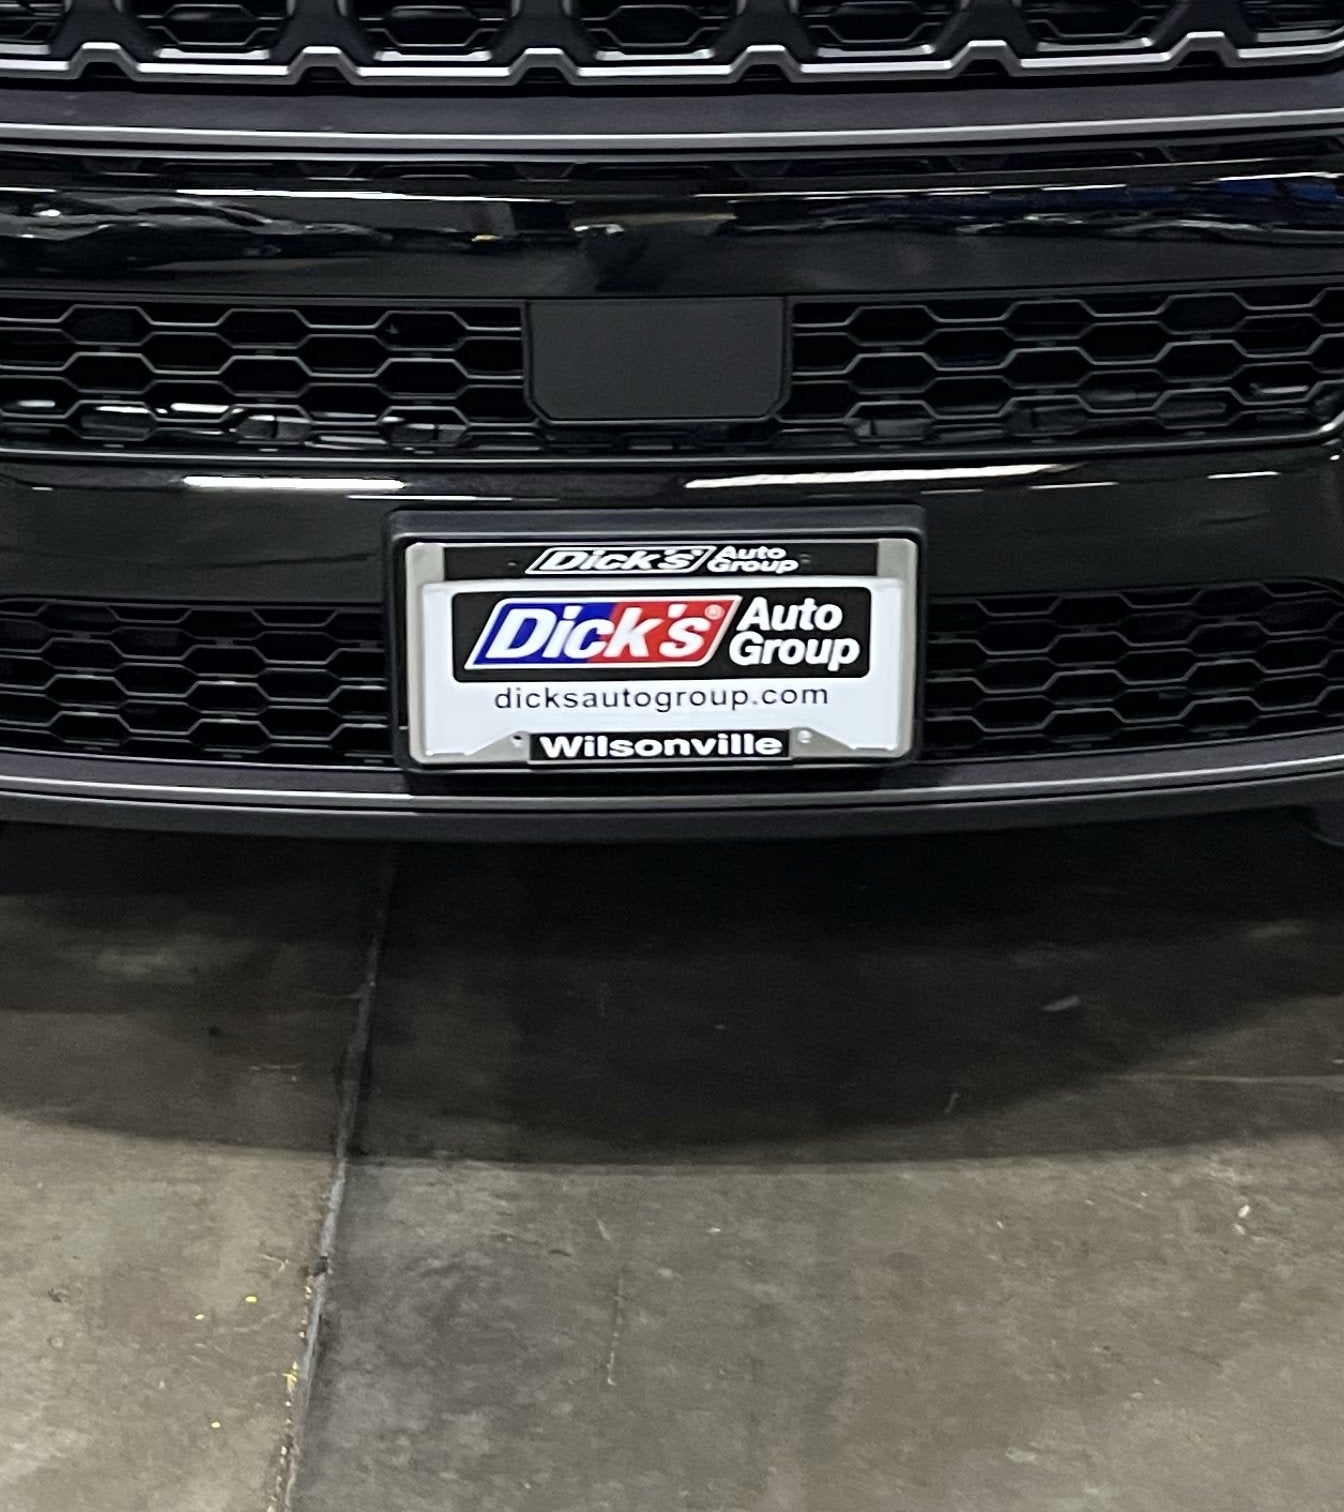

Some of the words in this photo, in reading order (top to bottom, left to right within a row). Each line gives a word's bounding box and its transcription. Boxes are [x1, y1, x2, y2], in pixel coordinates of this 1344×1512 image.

[539, 548, 696, 571] Dick's
[714, 545, 787, 560] Auto
[706, 557, 800, 575] Group
[736, 596, 843, 632] Auto
[484, 603, 710, 660] Dick's
[729, 631, 861, 673] Group
[494, 686, 829, 713] dicksautogroup.com
[539, 733, 784, 759] Wilsonville
